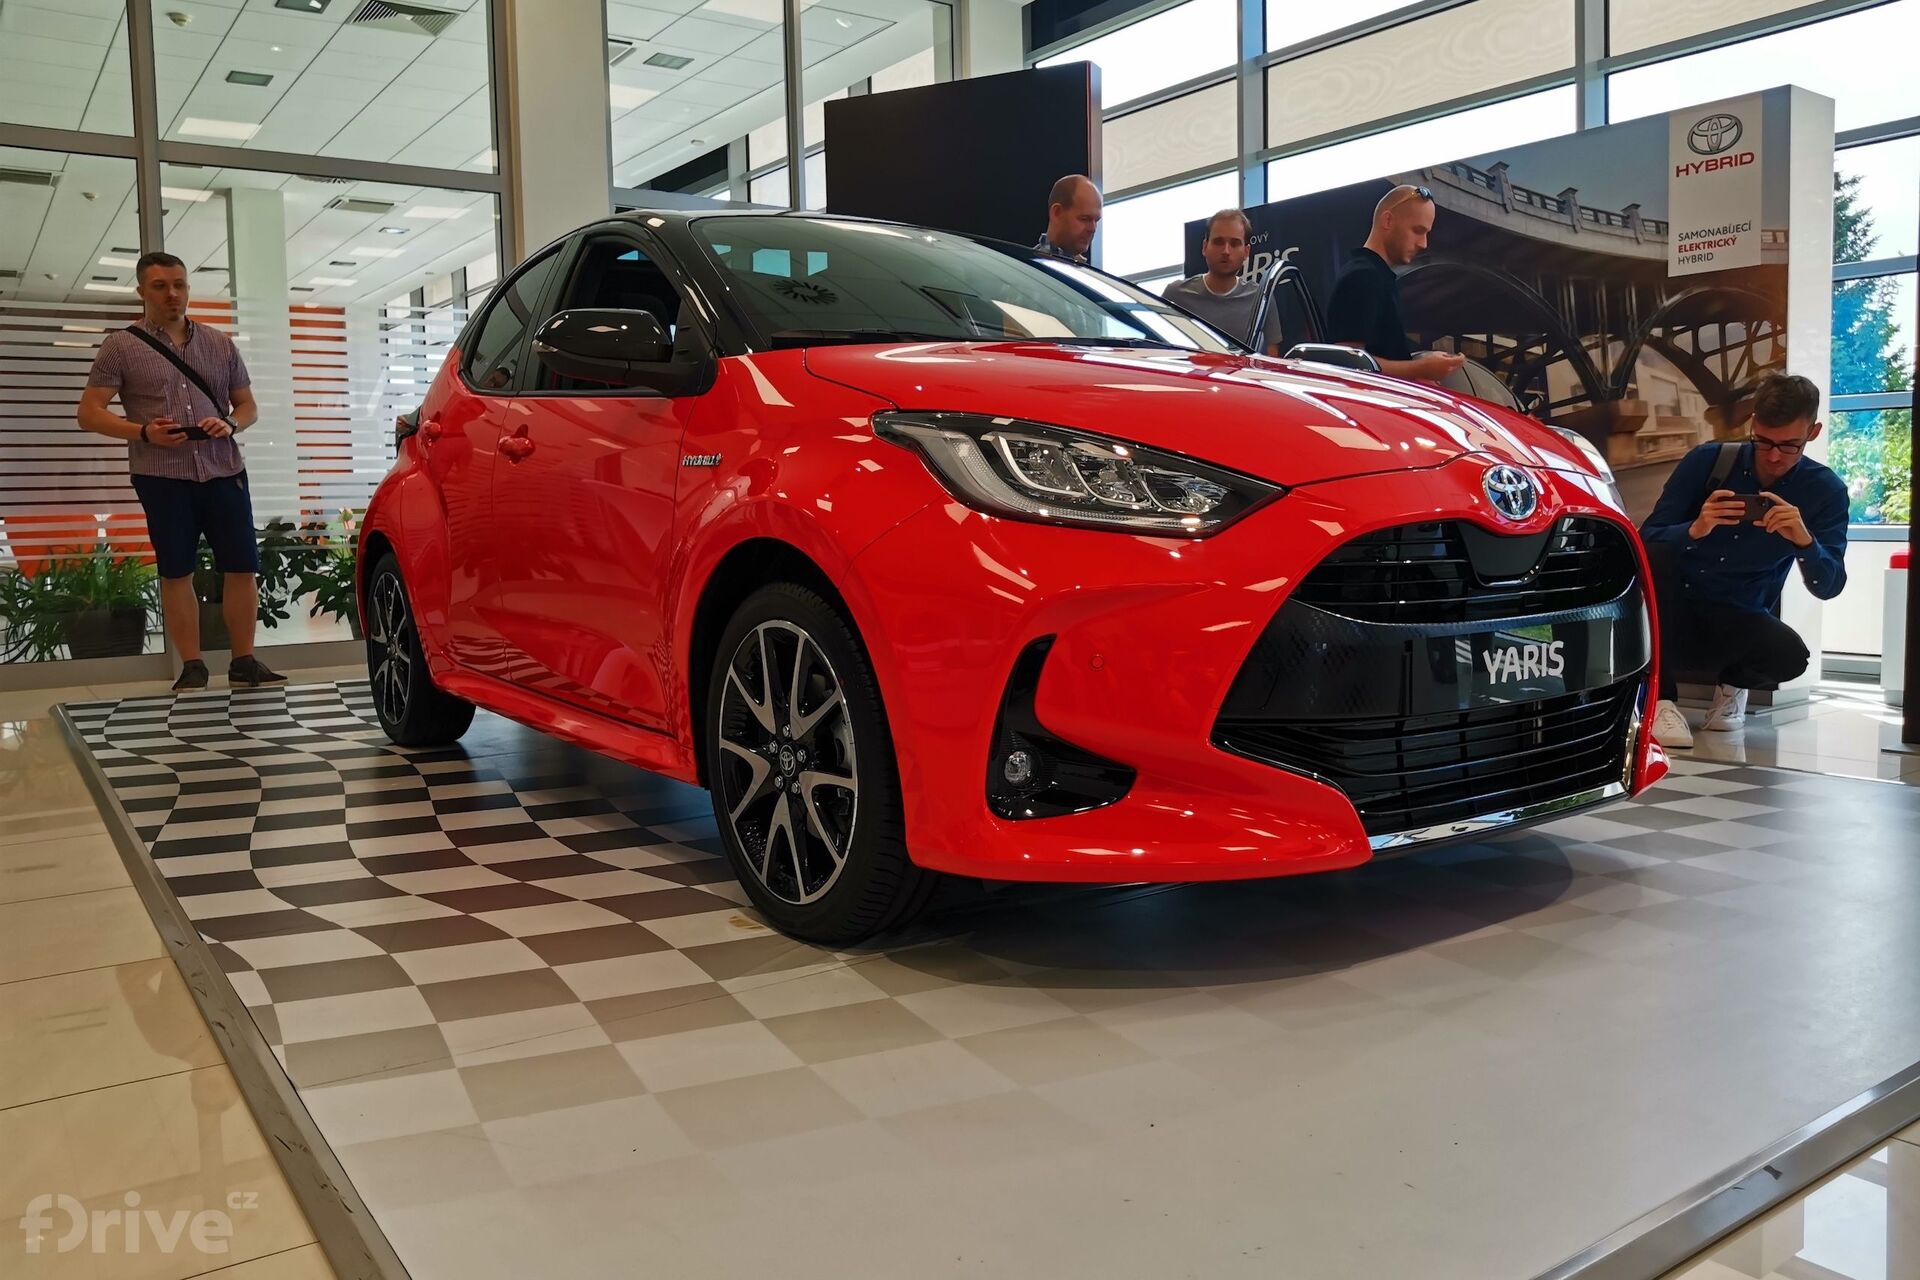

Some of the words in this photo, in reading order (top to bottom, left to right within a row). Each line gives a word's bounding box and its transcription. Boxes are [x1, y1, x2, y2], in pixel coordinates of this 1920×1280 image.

[1676, 152, 1755, 178] HYBRID
[1249, 231, 1269, 245] OVÝ
[1678, 220, 1752, 242] SAMONABÍJECÍ
[1678, 235, 1737, 253] ELEKTRICKÝ
[1678, 252, 1714, 265] HYBRID
[1483, 640, 1564, 685] YARIS
